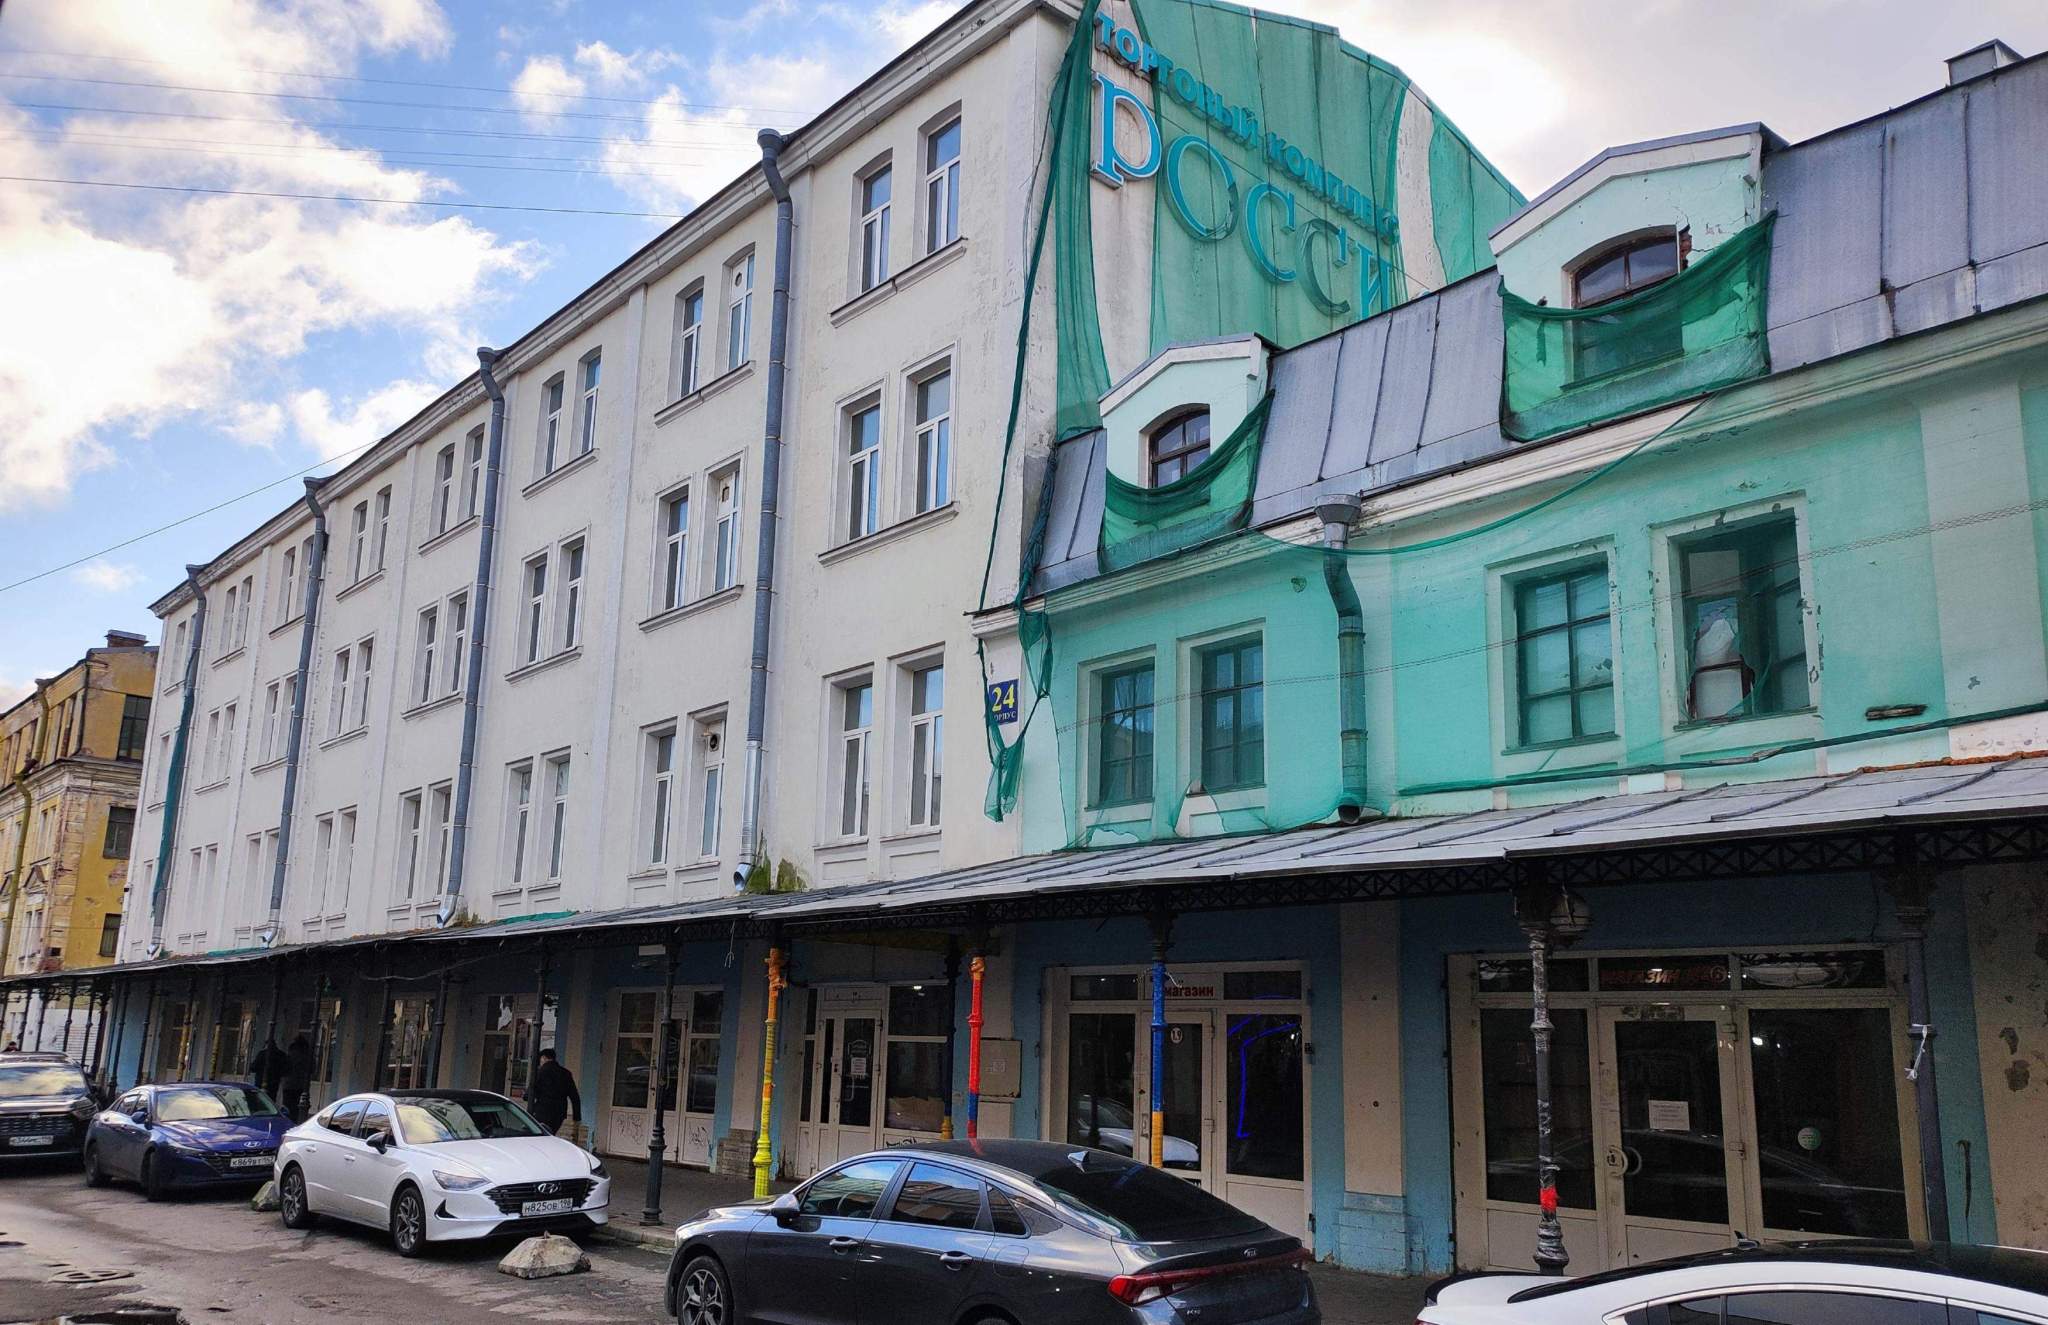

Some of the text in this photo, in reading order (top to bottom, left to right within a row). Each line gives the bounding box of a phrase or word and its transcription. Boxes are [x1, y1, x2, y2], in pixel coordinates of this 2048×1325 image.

[1095, 10, 1261, 151] ТОРГОВЫЙ
[1092, 71, 1430, 320] РОССИ
[992, 684, 1015, 712] 24
